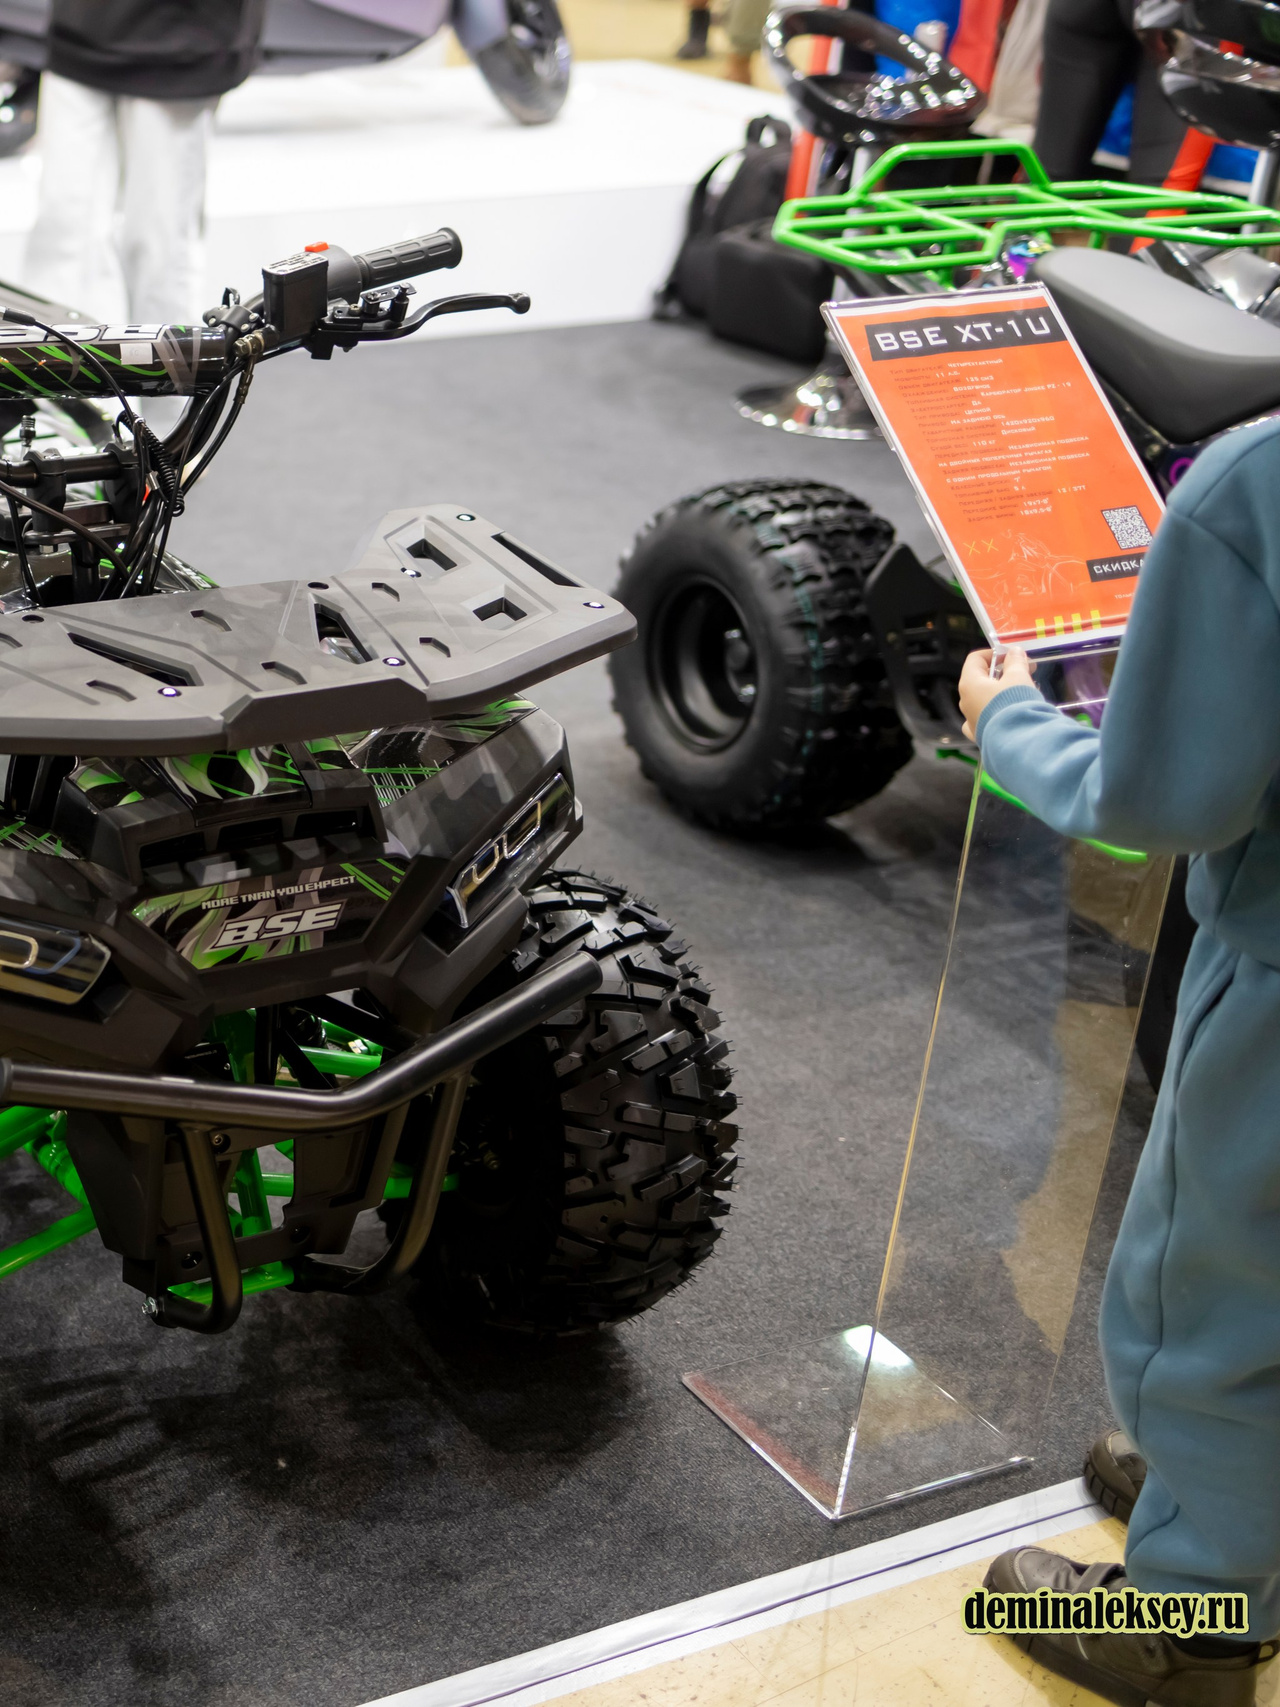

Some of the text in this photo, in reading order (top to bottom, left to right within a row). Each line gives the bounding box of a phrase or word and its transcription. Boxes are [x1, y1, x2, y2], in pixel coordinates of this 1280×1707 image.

[874, 326, 948, 352] BSE
[201, 896, 239, 909] MORE
[276, 884, 304, 896] YOU
[211, 903, 343, 949] BSE
